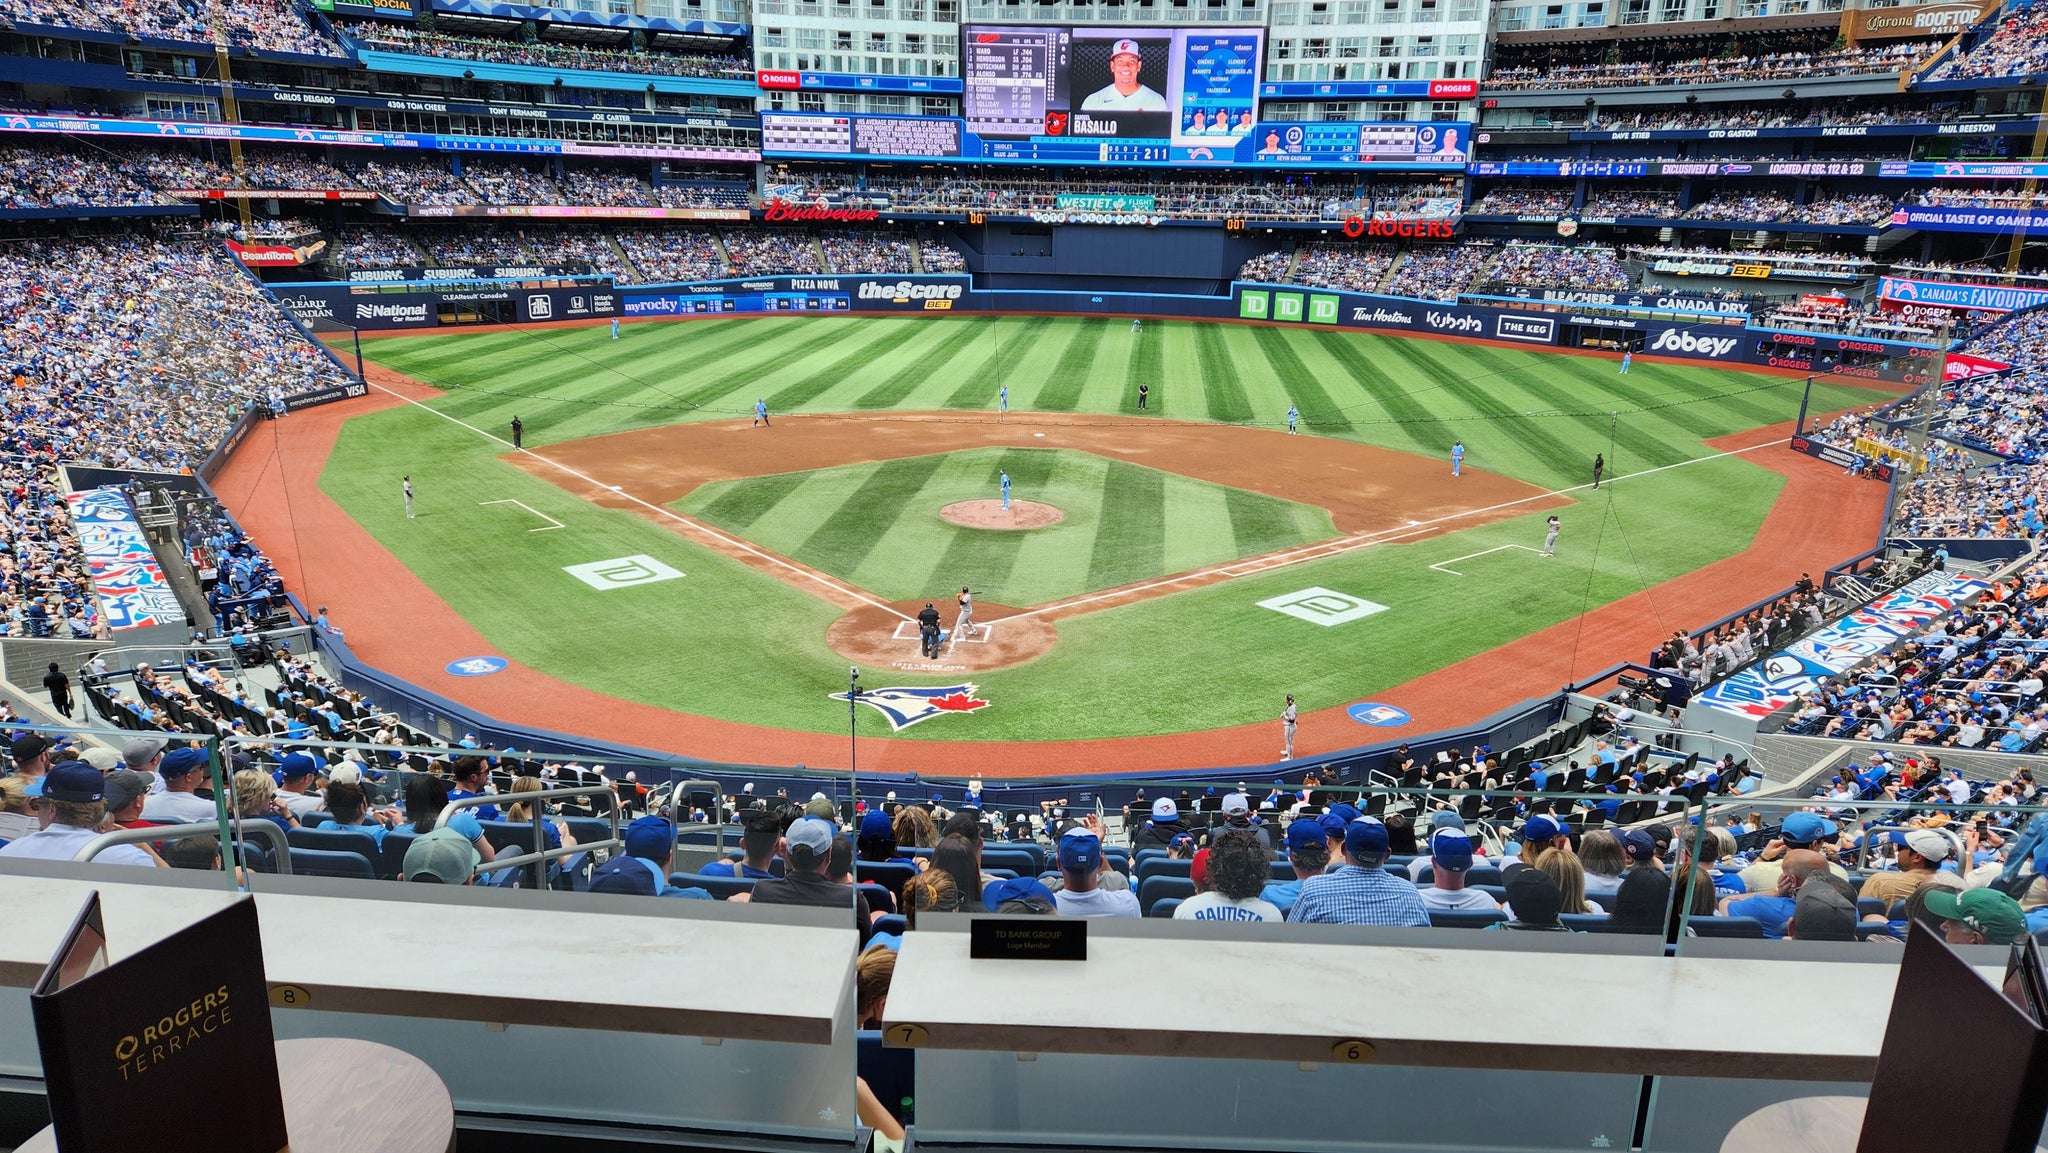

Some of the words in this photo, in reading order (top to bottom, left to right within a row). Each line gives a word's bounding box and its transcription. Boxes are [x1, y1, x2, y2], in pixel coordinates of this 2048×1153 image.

[374, 0, 412, 10] SOCIAL
[1866, 16, 1912, 32] Corona
[1914, 9, 1981, 28] ROOFTOP
[1930, 25, 1959, 34] PATIO
[1059, 32, 1069, 44] 29
[1060, 54, 1066, 65] C
[770, 75, 796, 84] ROGERS
[274, 93, 301, 102] CARLOS
[303, 94, 336, 104] DELGADO
[387, 101, 406, 110] 4306
[407, 102, 423, 110] TOM
[425, 104, 447, 112] CHEEK
[489, 107, 507, 115] TONY
[510, 109, 547, 118] FERNANDEZ
[59, 120, 90, 130] FAVOURITE
[714, 118, 728, 126] BELL
[1074, 120, 1118, 134] BASALLO
[204, 126, 231, 136] FAVOURITE
[1838, 128, 1867, 136] GILLICK
[1938, 125, 1958, 134] PAUL
[1958, 124, 1996, 133] BEESTON
[338, 134, 363, 142] FAVOURITE
[1290, 132, 1298, 140] 23
[1478, 134, 1490, 142] CC
[1144, 148, 1152, 160] 2
[1154, 148, 1159, 160] 1
[1162, 148, 1168, 160] 1
[1662, 165, 1708, 175] EXCLUSIVELY
[1710, 164, 1719, 174] AT
[1769, 164, 1801, 175] LOCATED
[1801, 164, 1811, 175] AT
[1811, 164, 1827, 175] SEC.
[1827, 164, 1841, 175] 112
[1840, 164, 1849, 175] &
[1849, 164, 1864, 175] 123
[1991, 165, 2023, 175] FAVOURITE
[1058, 196, 1112, 208] WESTJET
[1128, 198, 1154, 206] FLIGHT
[418, 206, 454, 216] myrocky
[760, 196, 880, 221] Budweiser
[694, 210, 740, 220] myrocky.ca
[1034, 212, 1066, 223] VOTE
[1080, 214, 1113, 224] BLUE
[1115, 214, 1148, 225] JAYS
[1910, 213, 1944, 223] OFFICIAL
[1945, 214, 1976, 225] TASTE
[1977, 215, 1994, 225] OF
[1996, 216, 2030, 226] GAME
[1368, 218, 1454, 238] ROGERS
[240, 251, 294, 261] BeautiTone
[422, 268, 476, 280] SUBWAY
[493, 268, 546, 278] SUBWAY
[1654, 260, 1728, 275] theScore
[1733, 267, 1767, 276] BET
[1774, 269, 1819, 277] SPORTSBOOK
[1824, 271, 1850, 279] CASINO
[350, 270, 404, 282] SUBWAY
[791, 278, 816, 290] PIZZA
[817, 279, 840, 290] NOVA
[858, 281, 962, 299] theScore
[1544, 290, 1616, 306] BLEACHERS
[1921, 288, 1968, 302] CANADA'S
[282, 296, 326, 310] CLEARLY
[624, 299, 678, 313] myrocky
[1244, 296, 1266, 313] TD
[1278, 298, 1300, 315] TD
[1314, 300, 1335, 318] TD
[1657, 297, 1716, 313] CANADA
[1719, 302, 1749, 314] DRY
[294, 309, 334, 318] NADIAN
[372, 304, 428, 317] National
[1353, 307, 1372, 321] Tim
[1373, 308, 1412, 324] Hortons
[1914, 306, 1952, 316] ROGERS
[1426, 310, 1482, 332] Kubota
[1570, 316, 1592, 324] Active
[1504, 322, 1524, 332] THE
[1526, 324, 1547, 334] KEG
[1651, 328, 1738, 357] Sobeys
[1782, 334, 1816, 346] ROGERS
[1848, 342, 1885, 353] ROGERS
[1777, 358, 1811, 370] ROGERS
[1946, 362, 1972, 378] HEINZ
[1843, 366, 1879, 378] ROGERS
[346, 384, 366, 398] VISA
[1793, 438, 1810, 450] HEINZ
[592, 560, 658, 582] TD
[1278, 595, 1360, 616] TD
[1194, 906, 1264, 922] BAUTISTA
[995, 930, 1006, 939] TD
[1032, 931, 1062, 940] GROUP
[1008, 942, 1022, 950] Loge
[282, 989, 296, 1004] 8
[143, 984, 230, 1046] ROGERS
[902, 1028, 914, 1043] 7
[117, 1006, 232, 1082] TERRACE
[1348, 1045, 1360, 1060] 6
